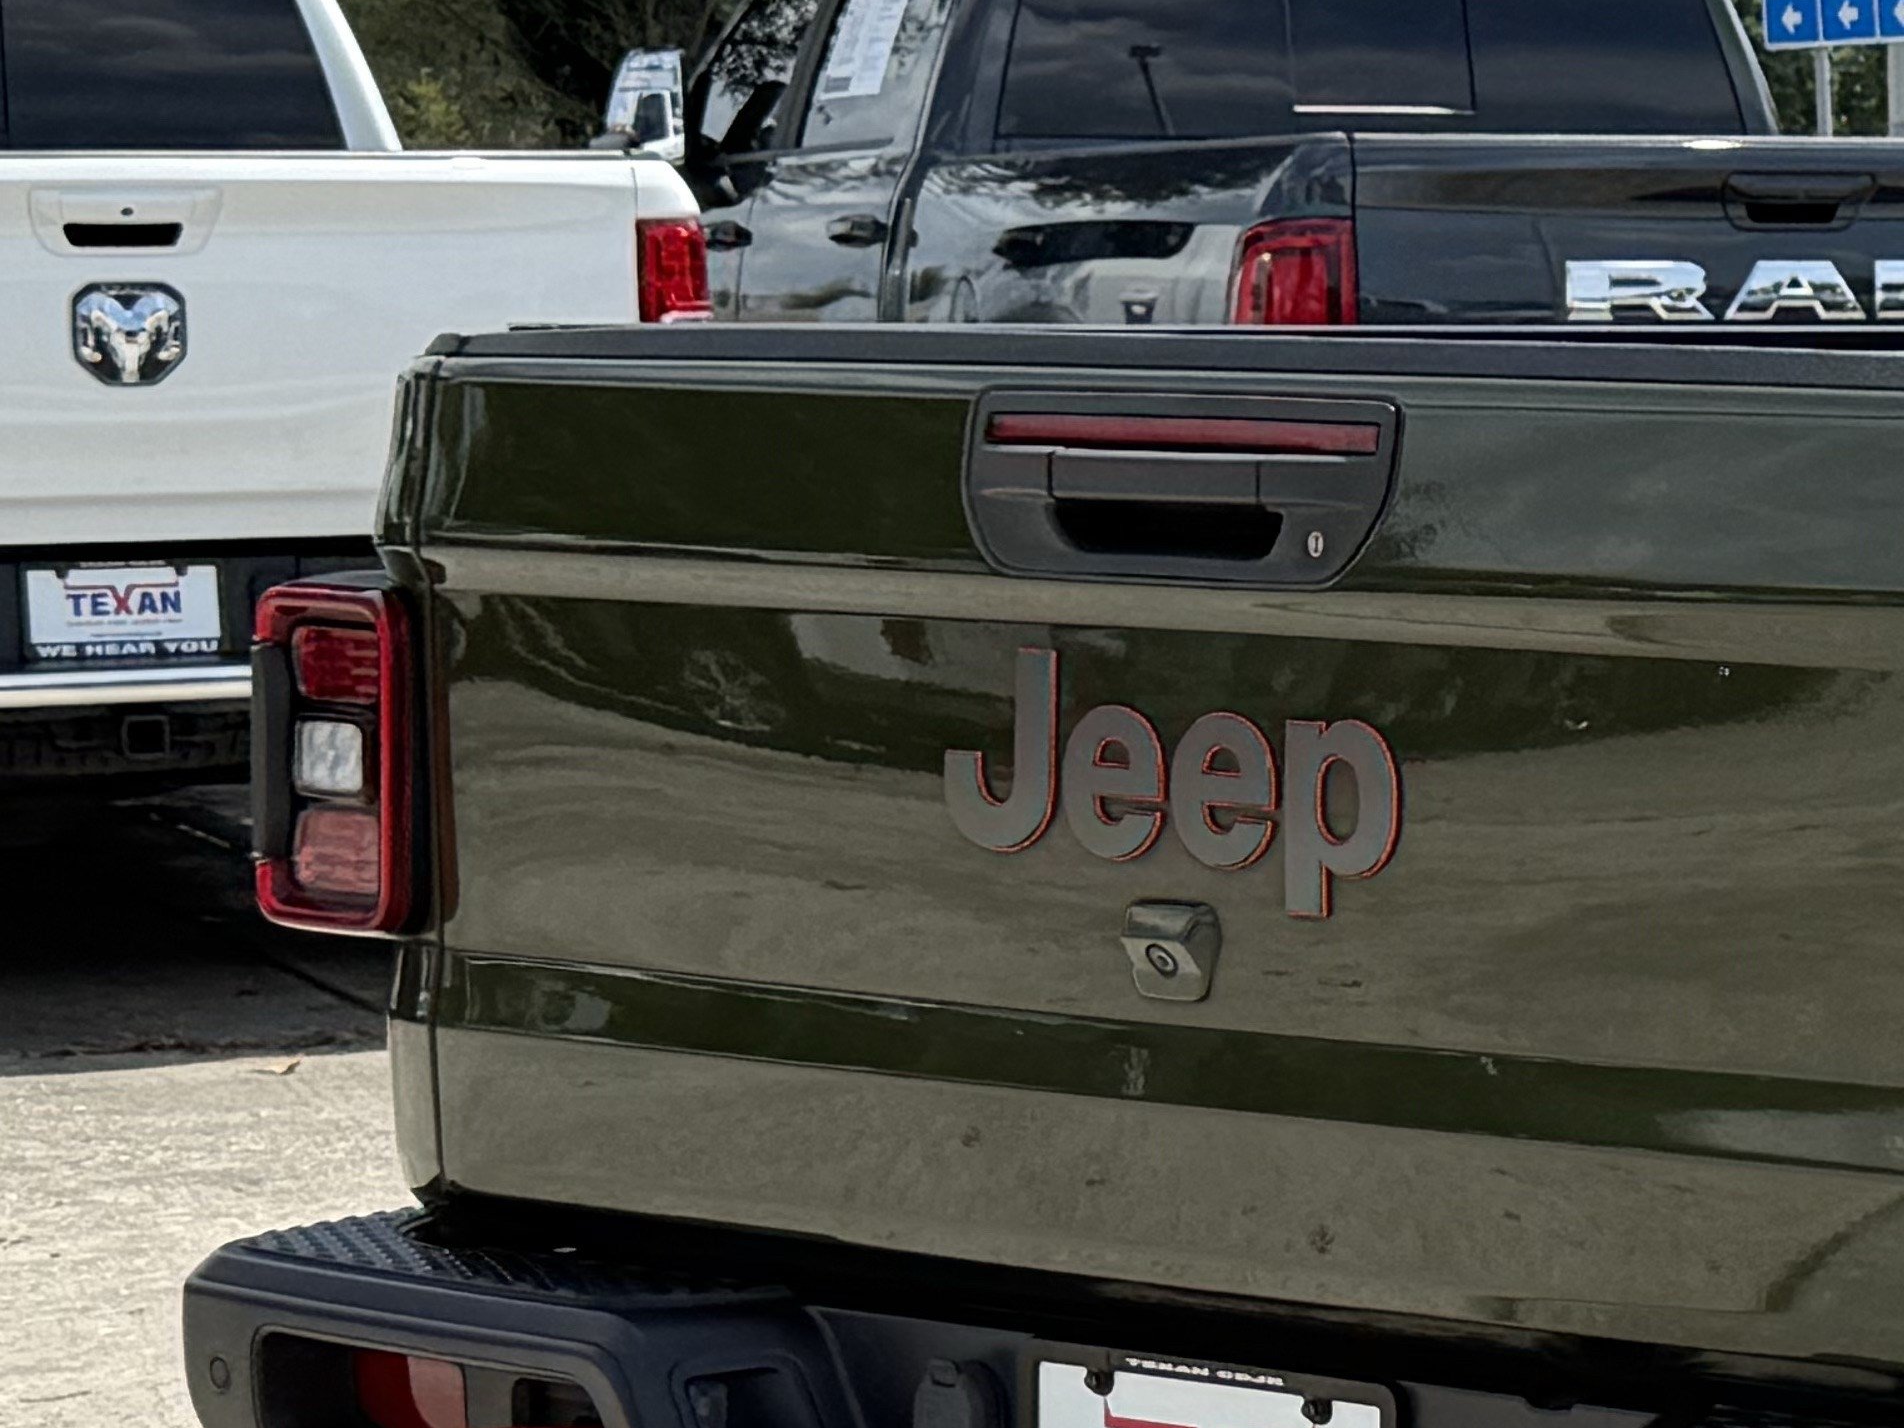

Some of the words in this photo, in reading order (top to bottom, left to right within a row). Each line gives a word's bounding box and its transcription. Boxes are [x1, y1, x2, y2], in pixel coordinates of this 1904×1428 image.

[65, 584, 183, 618] TEXAN
[36, 644, 77, 658] WE
[84, 641, 156, 656] HEAR
[162, 639, 219, 653] YOU
[943, 646, 1404, 921] Jeep
[1125, 1357, 1210, 1377] TEXAN
